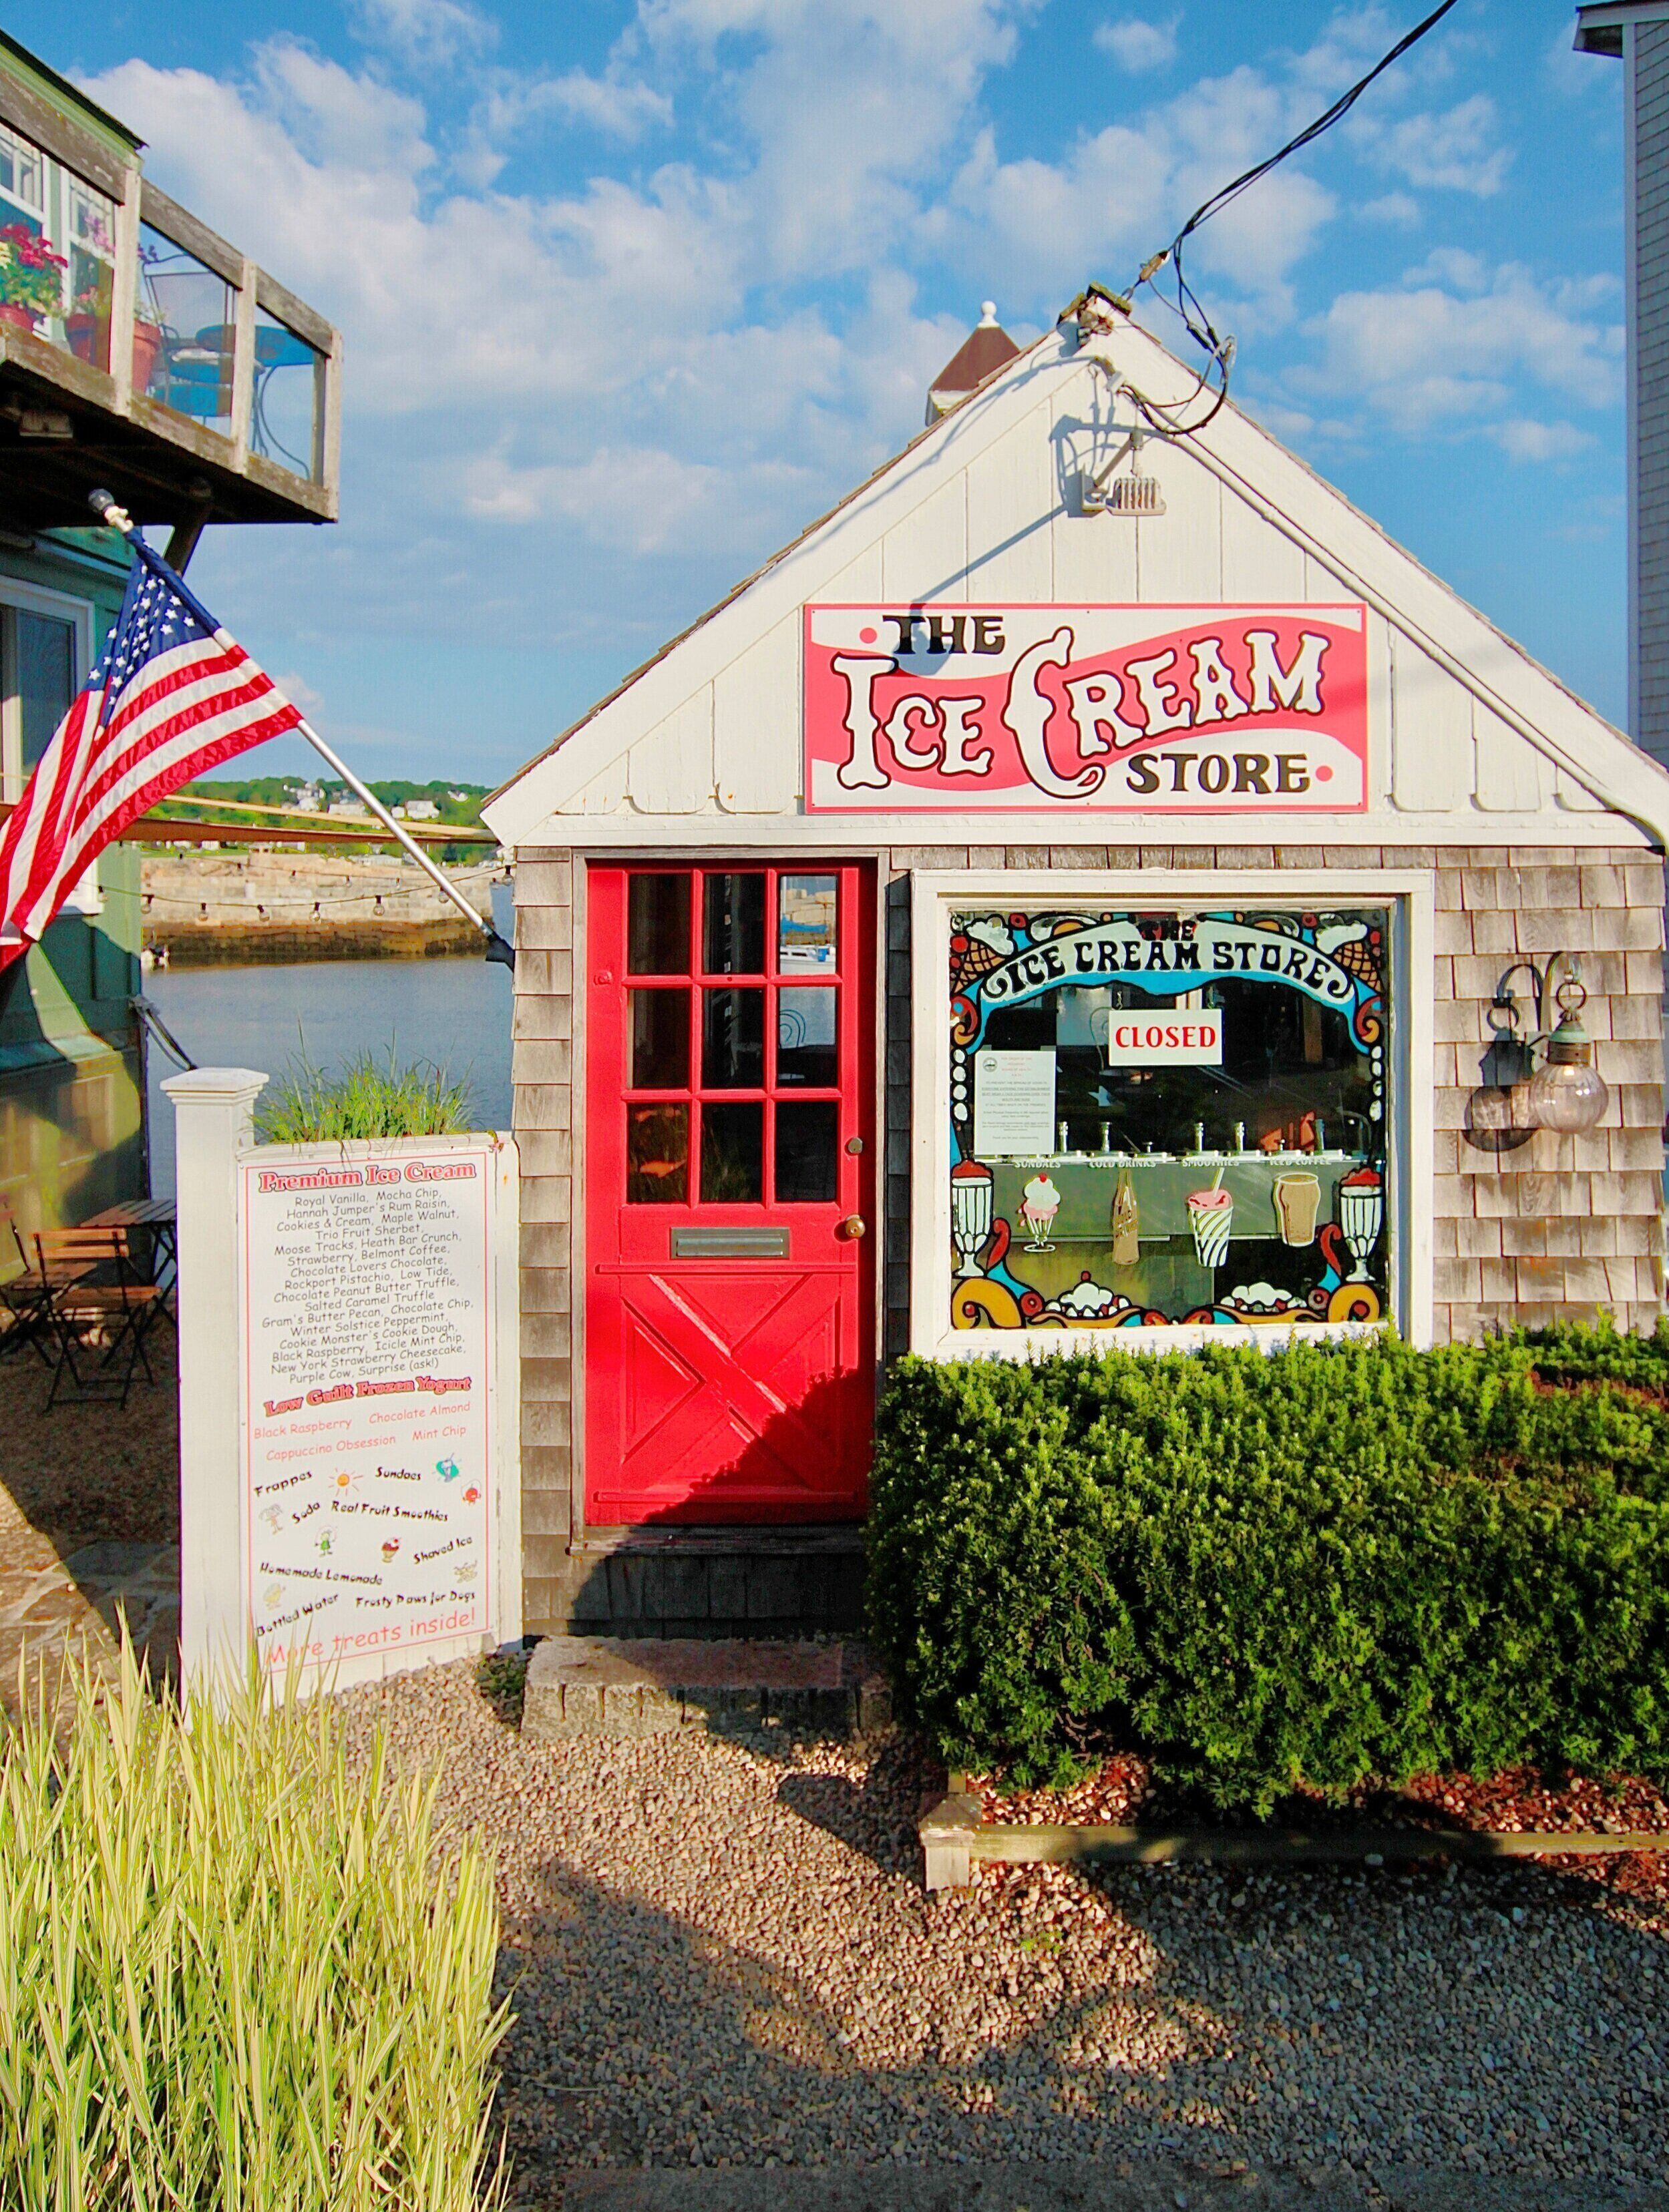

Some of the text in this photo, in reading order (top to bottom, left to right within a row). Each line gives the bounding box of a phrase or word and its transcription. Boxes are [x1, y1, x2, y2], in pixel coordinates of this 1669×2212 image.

[882, 614, 1006, 656] THE
[830, 626, 1332, 800] ICE CREAM
[1126, 752, 1310, 795] STORE
[1004, 940, 1333, 993] ICE CREAM STORE
[1115, 1026, 1216, 1048] CLOSED
[259, 1162, 476, 1192] Premium Ice Cream
[287, 1198, 450, 1219] Hannah Jumper's Rum Raisin,
[295, 1188, 441, 1208] Royal Vanilla, Mocha Chip,
[276, 1209, 459, 1232] Cookies & Cream, Maple Walnut,
[315, 1223, 423, 1240] Trio Fruit Sherbet,
[274, 1231, 461, 1255] Moose Tracks, Heath Bar Crunch,
[287, 1244, 450, 1267] Strawberry, Belmont Coffee,
[291, 1256, 447, 1278] Chocolate Lovers Chocolate,
[274, 1277, 459, 1303] Chocolate Peanut Butter Truffle,
[285, 1267, 452, 1290] Rockport Pistachio, Low Tide,
[262, 1298, 474, 1328] Gram's Butter Pecan, Chocolate Chip,
[305, 1290, 435, 1312] Salted Caramel Truffle
[280, 1322, 457, 1349] Cookie Monster's Cookie Dough,
[291, 1312, 448, 1336] Winter Solstice Peppermint,
[272, 1333, 465, 1362] Black Raspberry, Icicle Mint Chip,
[271, 1345, 466, 1375] New York Strawberry Cheesecake,
[289, 1357, 439, 1385] Purple Cow, Surprise (ask!)
[264, 1376, 472, 1417] Low Guilt Frozen Yogurt
[369, 1401, 471, 1424] Chocolate Almond
[254, 1419, 352, 1440] Black Raspberry
[412, 1425, 466, 1441] Mint Chip
[266, 1435, 396, 1462] Cappuccino Obsession
[254, 1471, 313, 1497] Frappes
[375, 1466, 421, 1481] Sundaes
[292, 1502, 321, 1524] Soda
[331, 1500, 448, 1522] Real Fruit Smoothies
[413, 1536, 473, 1564] Shaved Ice
[260, 1562, 383, 1586] Homemade Lemonade
[355, 1590, 476, 1608] Frosty Paws for Dogs
[256, 1593, 339, 1637] Bottled Water
[332, 1625, 402, 1652] treats
[410, 1606, 476, 1636] inside!
